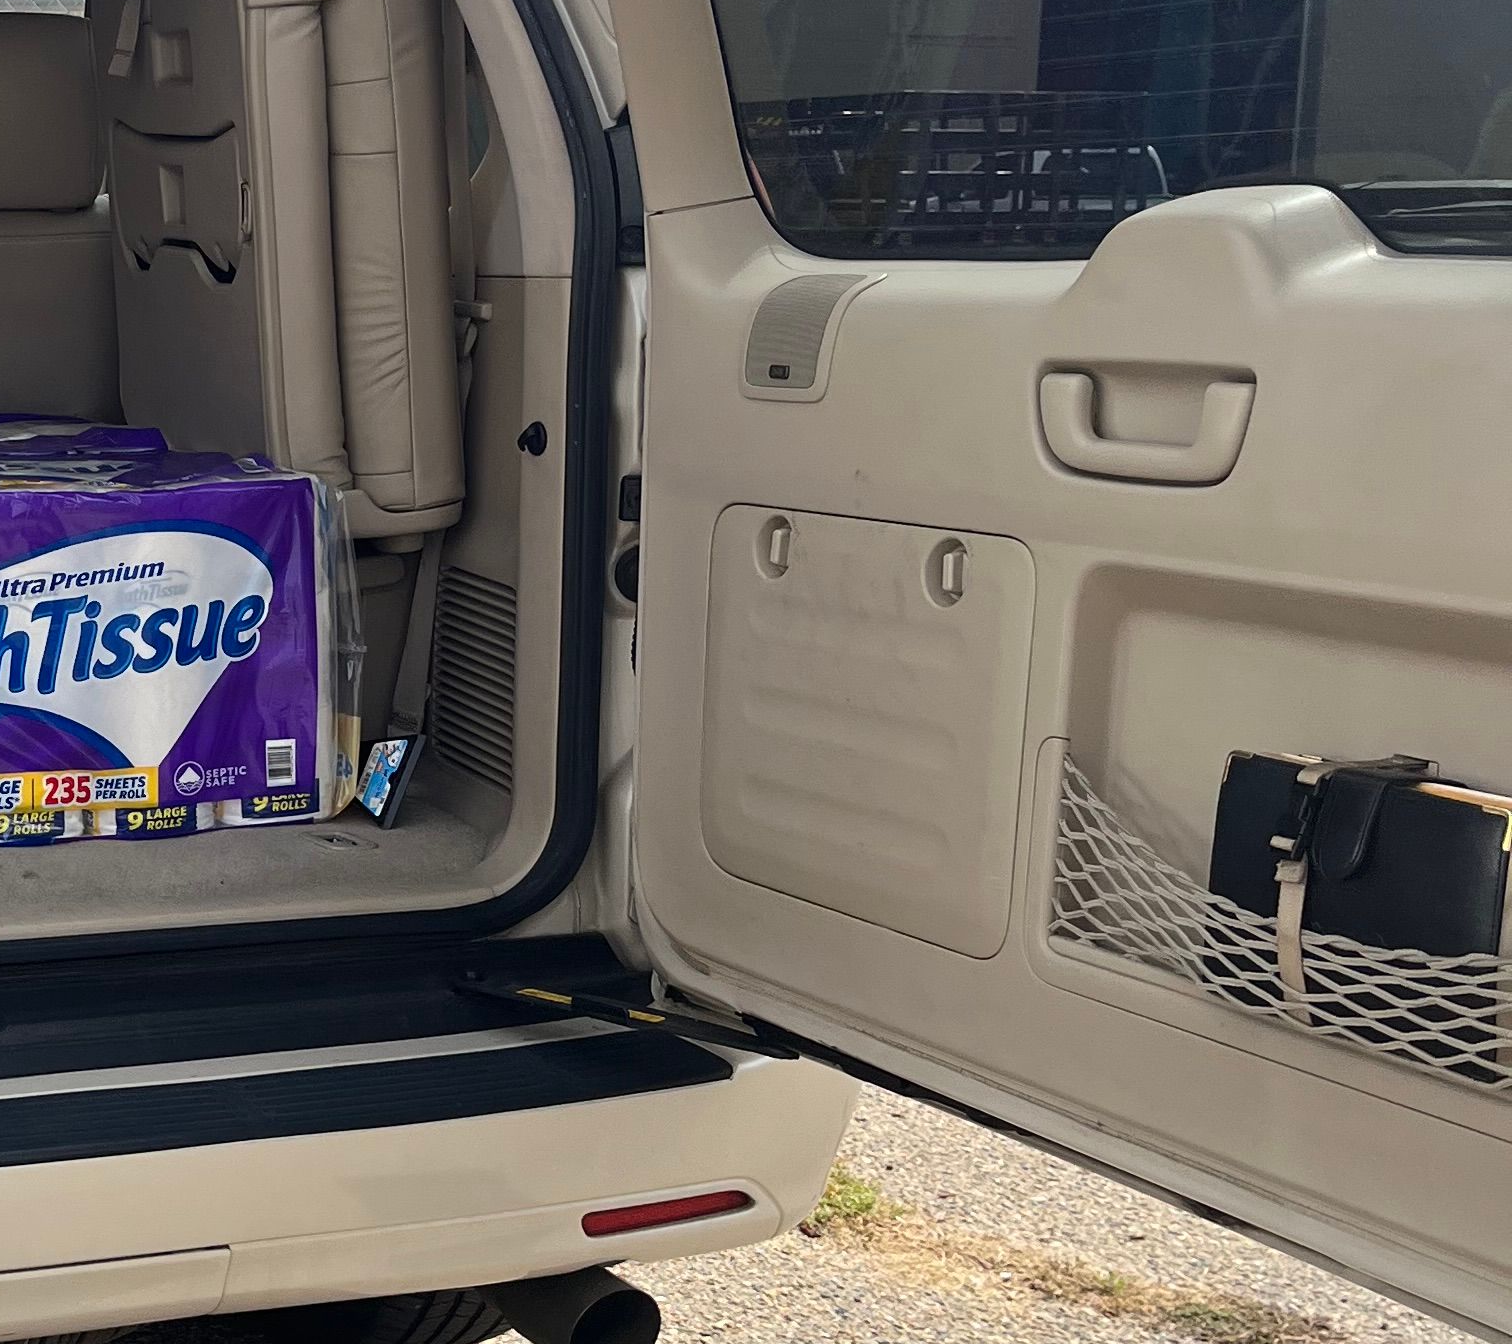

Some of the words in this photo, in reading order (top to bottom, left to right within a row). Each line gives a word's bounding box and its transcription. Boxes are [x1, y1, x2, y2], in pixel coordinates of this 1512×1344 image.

[50, 561, 165, 591] Premium
[206, 765, 248, 779] SEPTIC
[205, 775, 236, 788] SAFE
[44, 775, 91, 806] 235
[94, 775, 146, 790] SHEETS
[95, 789, 117, 801] PER
[118, 788, 147, 800] ROLL
[271, 798, 308, 813] ROLLS
[13, 811, 55, 825] LARGE
[127, 811, 144, 831] 9
[146, 805, 188, 820] LARGE
[146, 817, 185, 831] ROLLS
[13, 822, 52, 836] ROLLS
